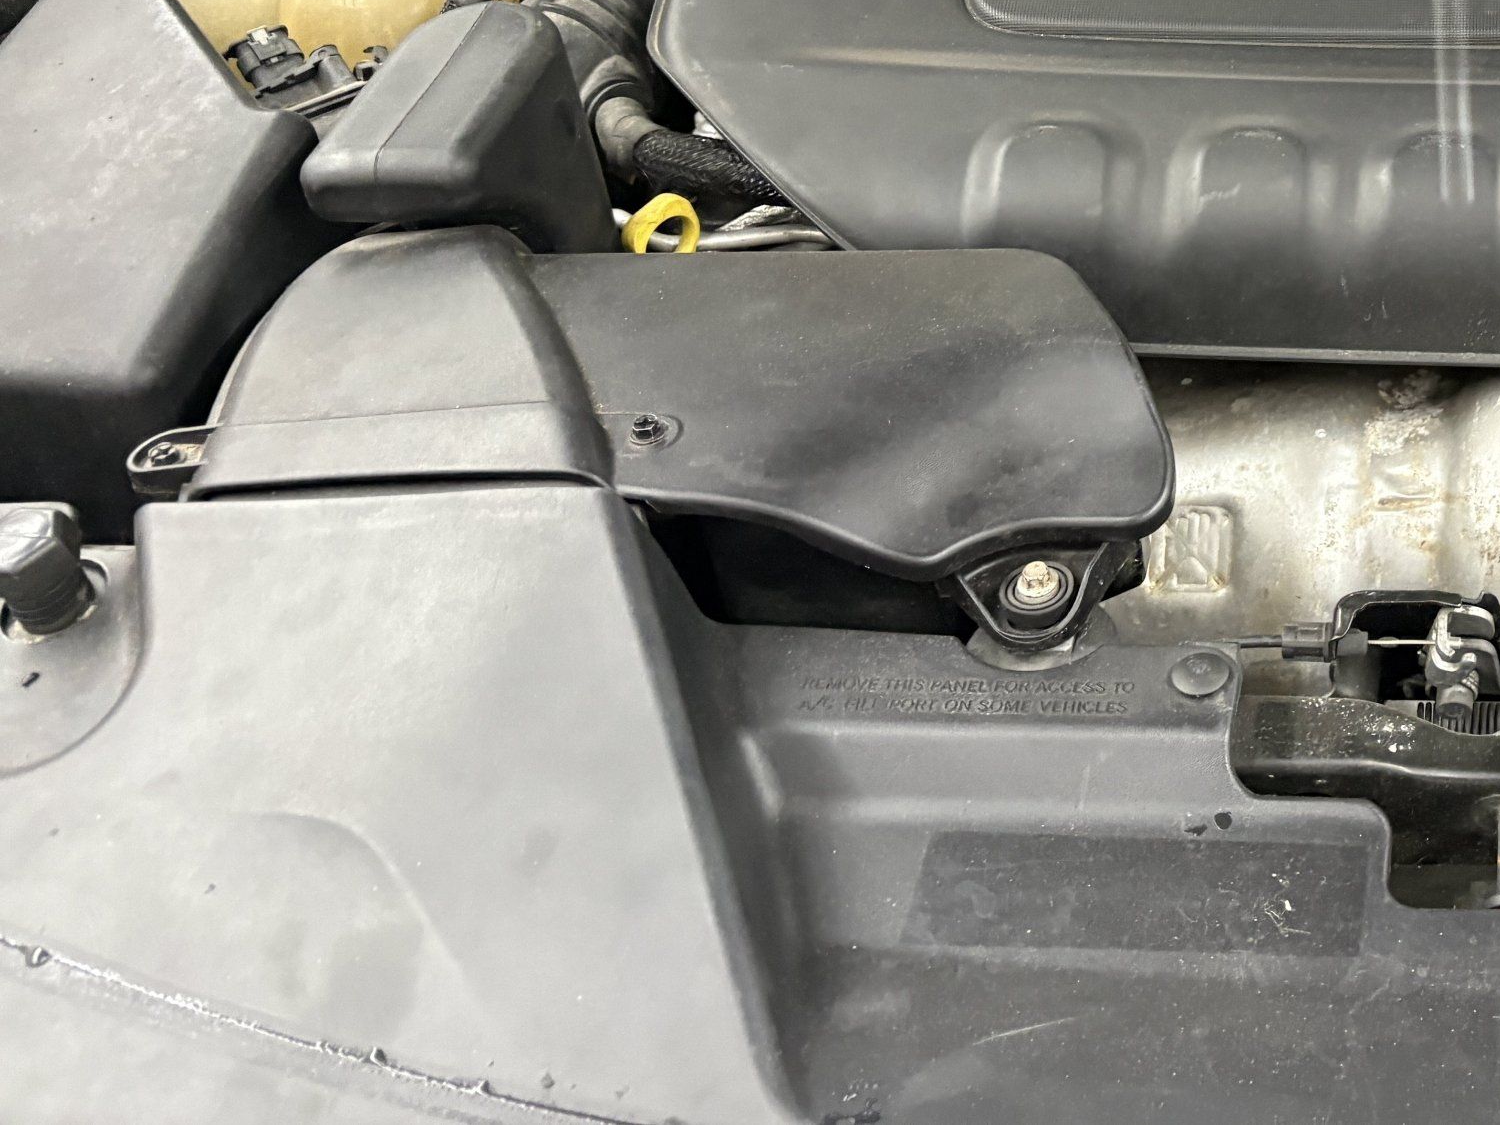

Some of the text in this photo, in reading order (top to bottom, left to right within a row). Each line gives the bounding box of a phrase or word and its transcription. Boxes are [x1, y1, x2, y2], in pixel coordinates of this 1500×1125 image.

[801, 676, 1136, 694] REMOVE THIS PANEL FOR ACCESS TO
[888, 698, 937, 712] PORT
[944, 699, 973, 712] ON
[977, 699, 1032, 713] SOME
[1039, 700, 1129, 714] VEHICLES
